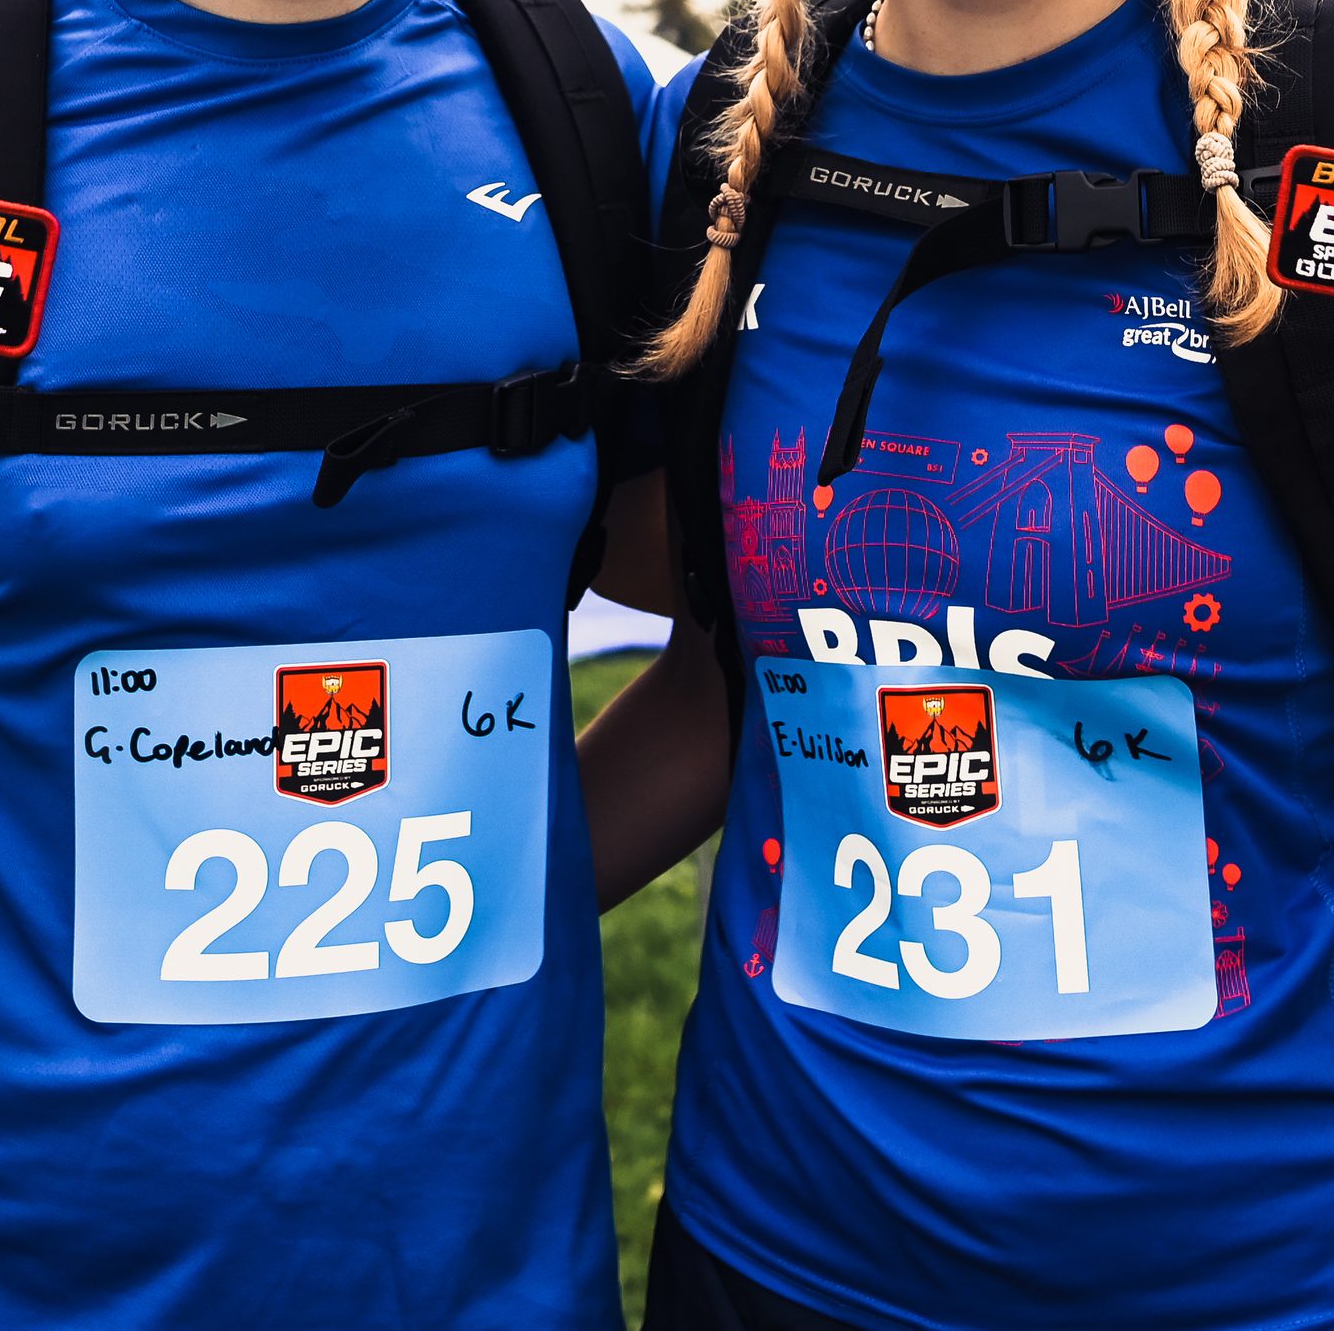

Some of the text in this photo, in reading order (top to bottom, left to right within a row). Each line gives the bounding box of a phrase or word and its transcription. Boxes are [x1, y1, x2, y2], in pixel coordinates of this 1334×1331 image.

[810, 166, 933, 207] GORUCK
[1122, 328, 1171, 347] great
[55, 412, 204, 430] GORUCK
[879, 439, 931, 457] SQUARE
[91, 667, 157, 696] 11:00
[764, 669, 808, 695] 11:00
[282, 729, 382, 763] EPIC
[297, 759, 367, 777] SERIES
[889, 751, 990, 784] EPIC
[301, 782, 349, 793] GORUCK
[904, 782, 976, 799] SERIES
[909, 805, 960, 815] GORUCK
[160, 810, 474, 981] 225
[832, 833, 1089, 999] 231
